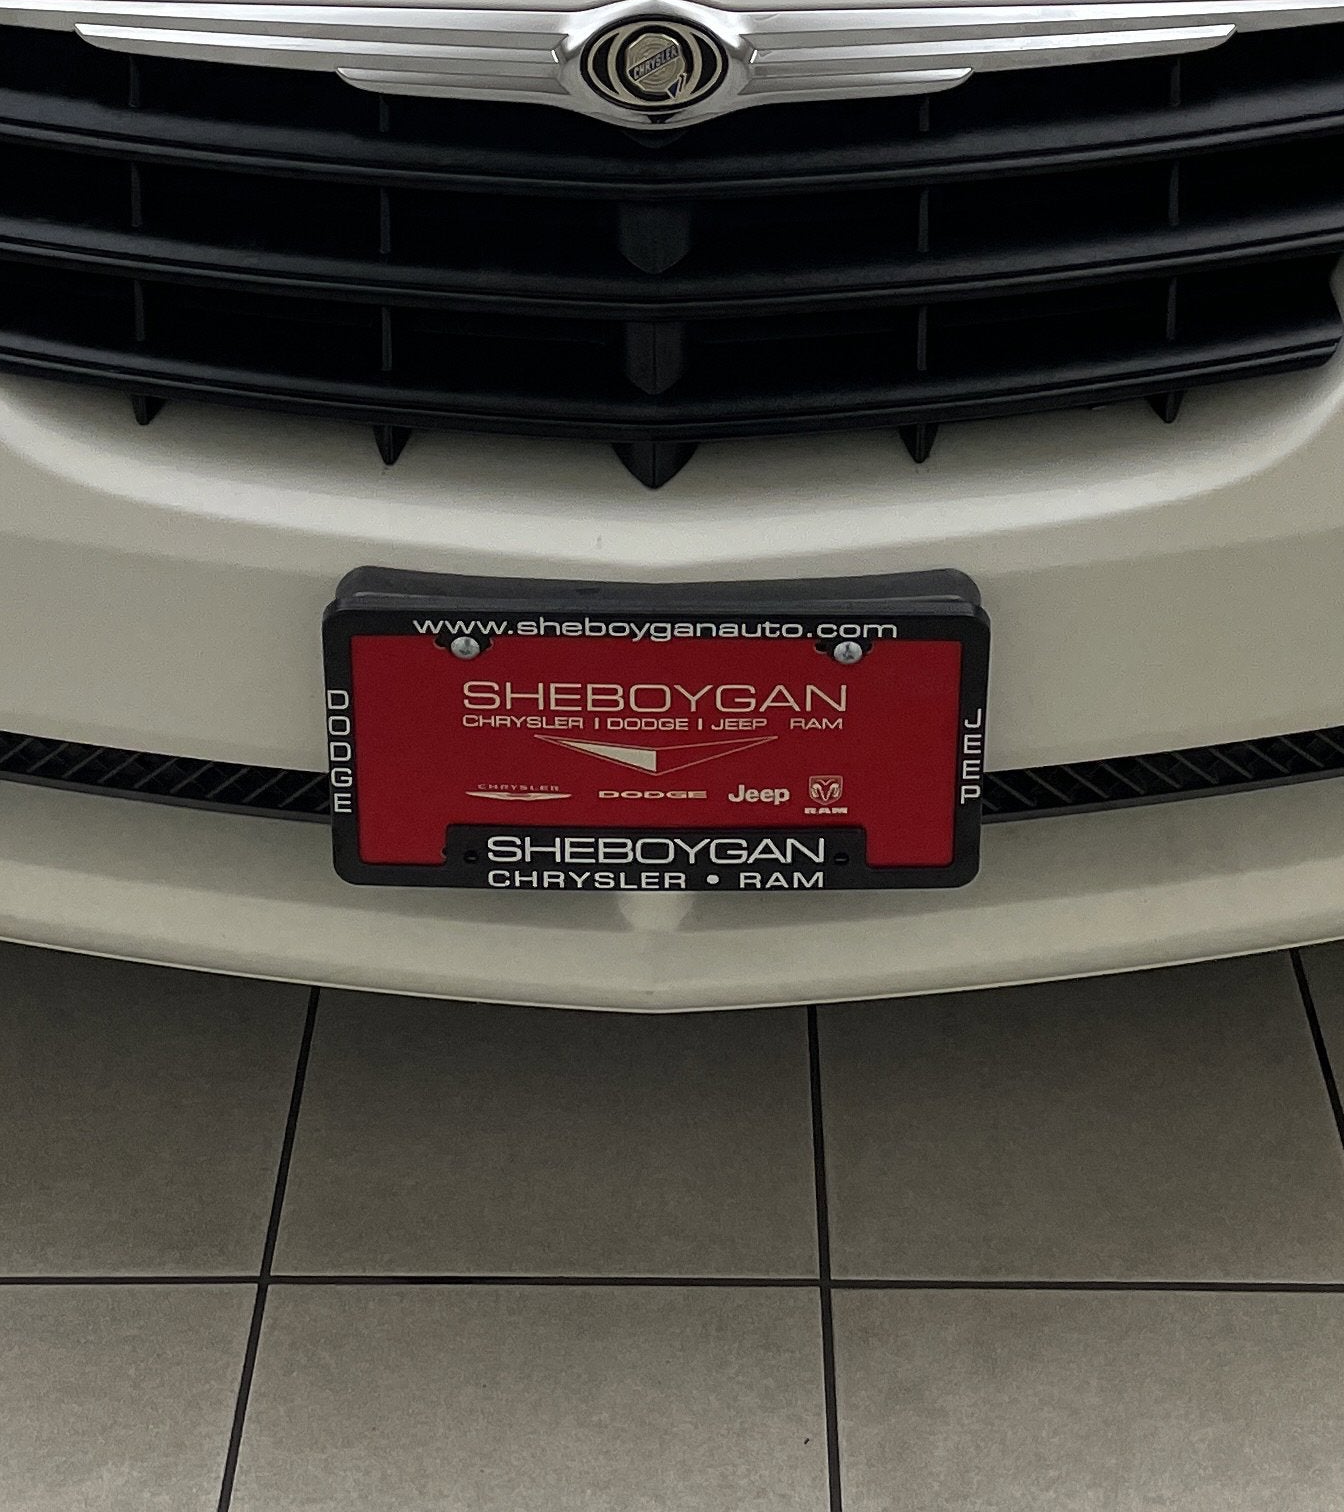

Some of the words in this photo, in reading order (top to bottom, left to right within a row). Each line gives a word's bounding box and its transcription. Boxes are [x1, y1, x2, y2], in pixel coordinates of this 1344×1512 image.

[633, 44, 678, 80] CHRYSLER
[412, 616, 899, 642] www.sheboyganauto.com
[462, 681, 848, 714] SHEBOYGAN
[462, 714, 584, 730] CHRYSLER
[607, 716, 690, 731] DODGE
[711, 716, 769, 731] JEEP
[789, 716, 844, 730] RAM
[327, 689, 354, 814] DODGE
[960, 709, 982, 806] JEEP
[477, 783, 560, 792] CHRYSLER
[598, 789, 708, 800] DODGE
[728, 783, 791, 806] Jeep
[803, 806, 849, 815] RAM
[486, 835, 825, 865] SHEBOYGAN
[486, 870, 687, 890] CHRYSLER
[738, 870, 826, 890] RAM
